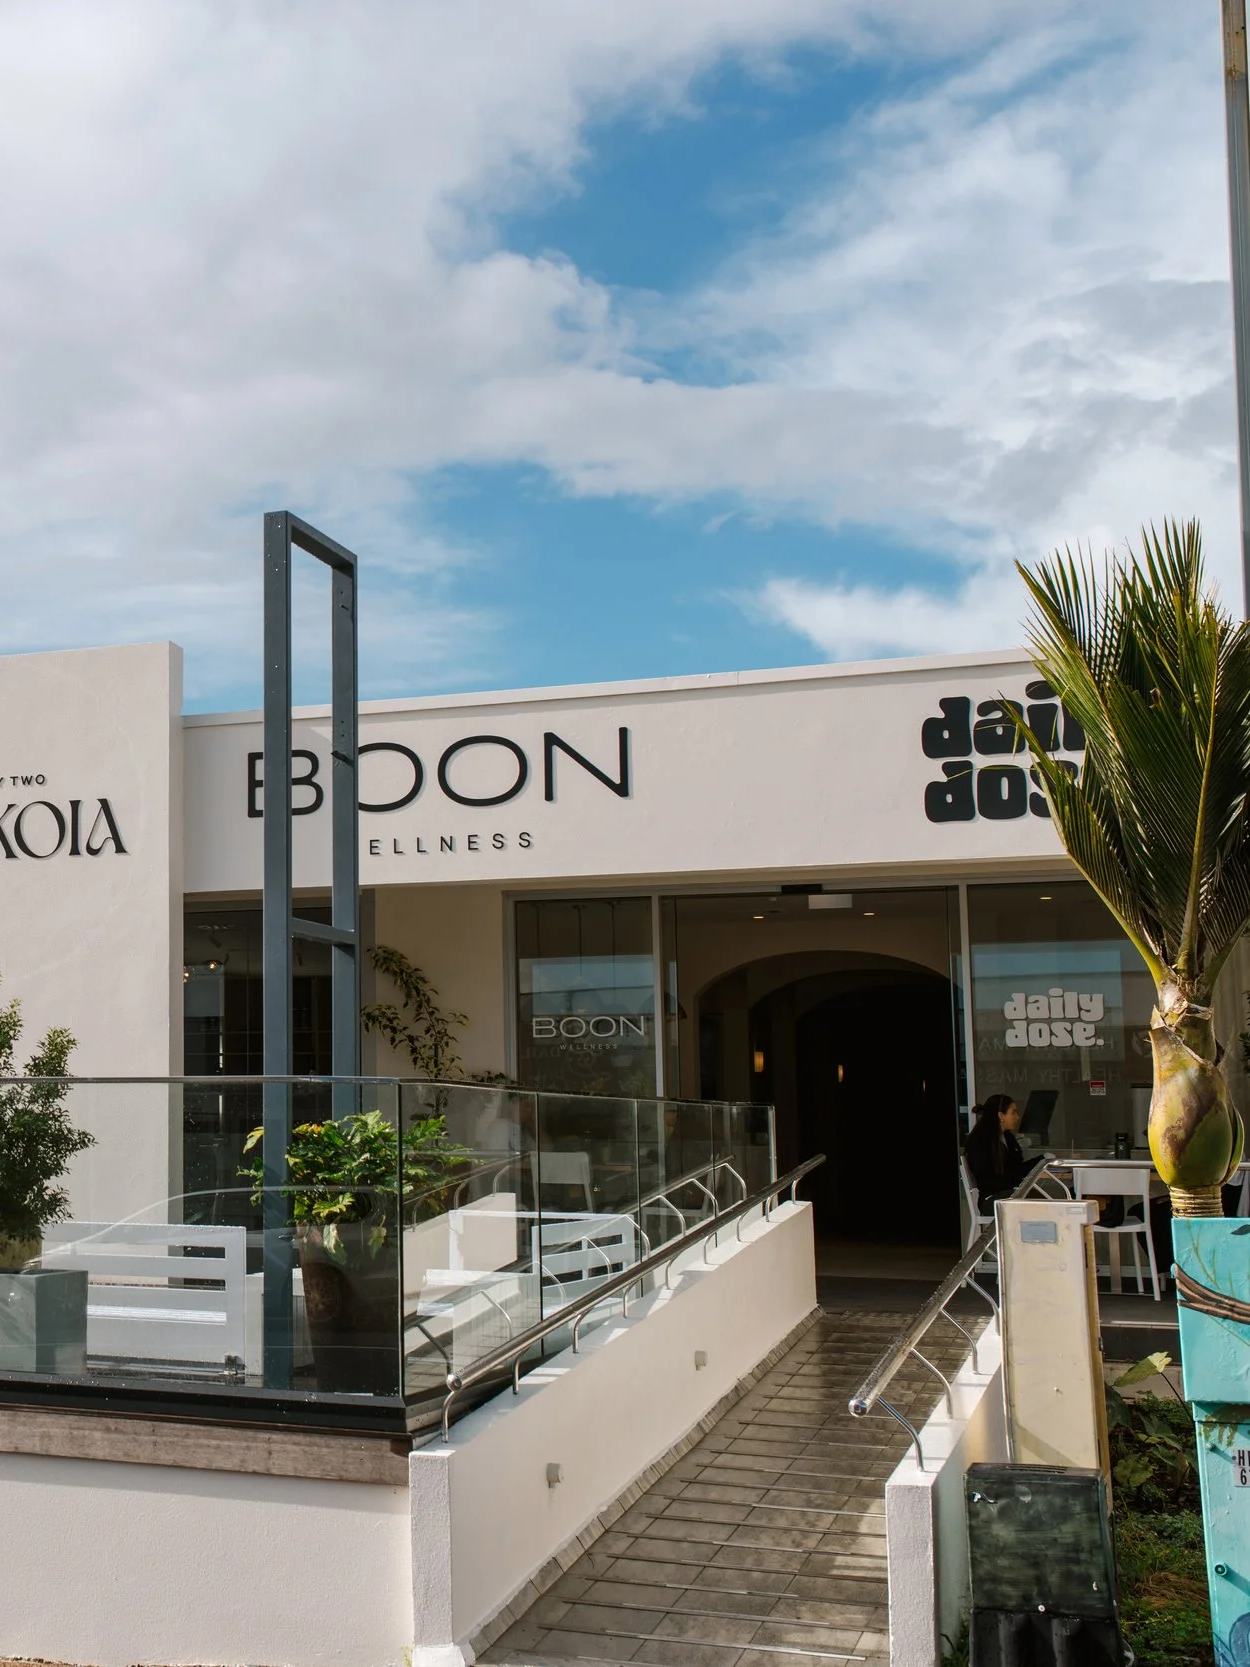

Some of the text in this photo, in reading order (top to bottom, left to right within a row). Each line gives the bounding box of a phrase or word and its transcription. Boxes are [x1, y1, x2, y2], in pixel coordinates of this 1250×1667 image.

[922, 680, 1087, 758] dail
[9, 773, 46, 786] TWO
[248, 727, 630, 818] BOON
[925, 760, 1079, 822] dos
[369, 831, 533, 855] ELLNESS
[1004, 987, 1104, 1021] daily
[532, 1015, 645, 1038] BOON
[1005, 1020, 1104, 1047] dose.
[559, 1043, 618, 1051] WELLNESS
[1238, 1449, 1250, 1466] H
[1240, 1468, 1250, 1485] 6
